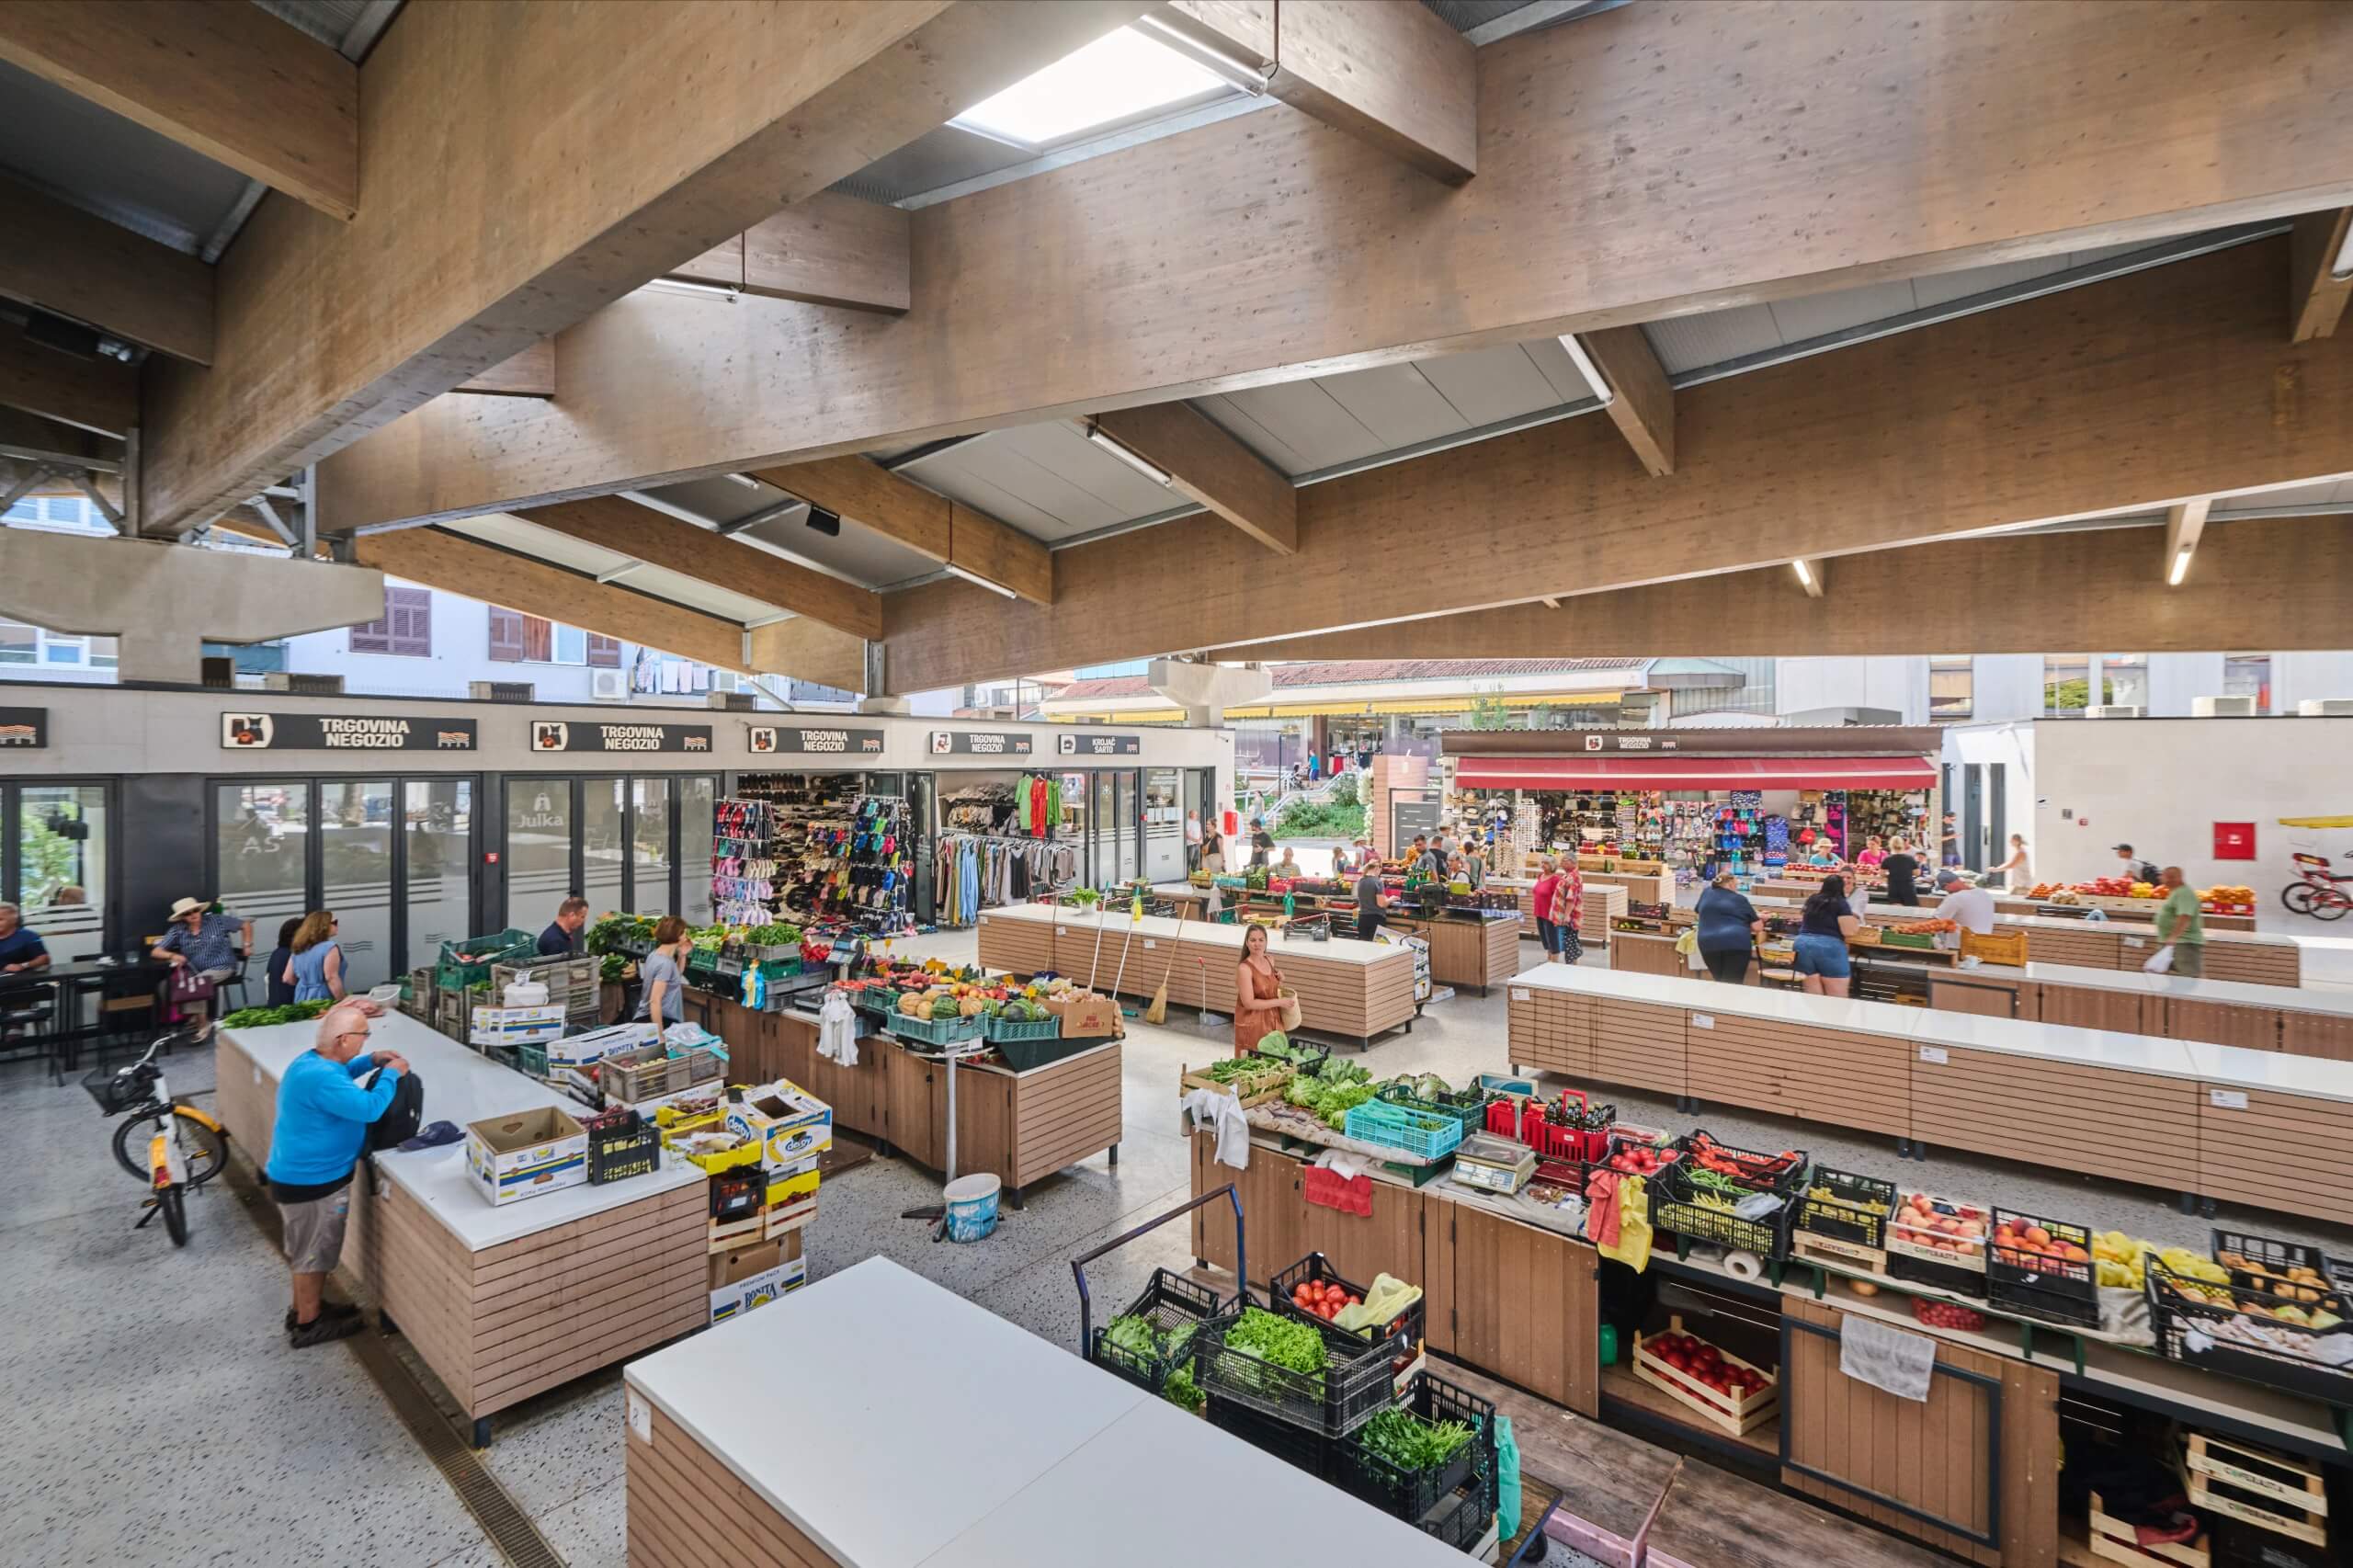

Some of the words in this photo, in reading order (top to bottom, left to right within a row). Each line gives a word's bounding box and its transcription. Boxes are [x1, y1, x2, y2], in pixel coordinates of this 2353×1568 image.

[319, 718, 410, 733] TRGOVINA
[600, 725, 664, 739] TRGOVINA
[800, 730, 848, 742] TRGOVINA
[325, 733, 404, 747] NEGOZIO
[605, 738, 660, 750] NEGOZIO
[969, 734, 1006, 744] TRGOVINA
[1092, 737, 1116, 746] KROJAČ
[803, 741, 845, 752] NEGOZIO
[972, 744, 1003, 753] NEGOZIO
[1095, 745, 1113, 754] SARTO
[745, 1281, 778, 1310] BONITA
